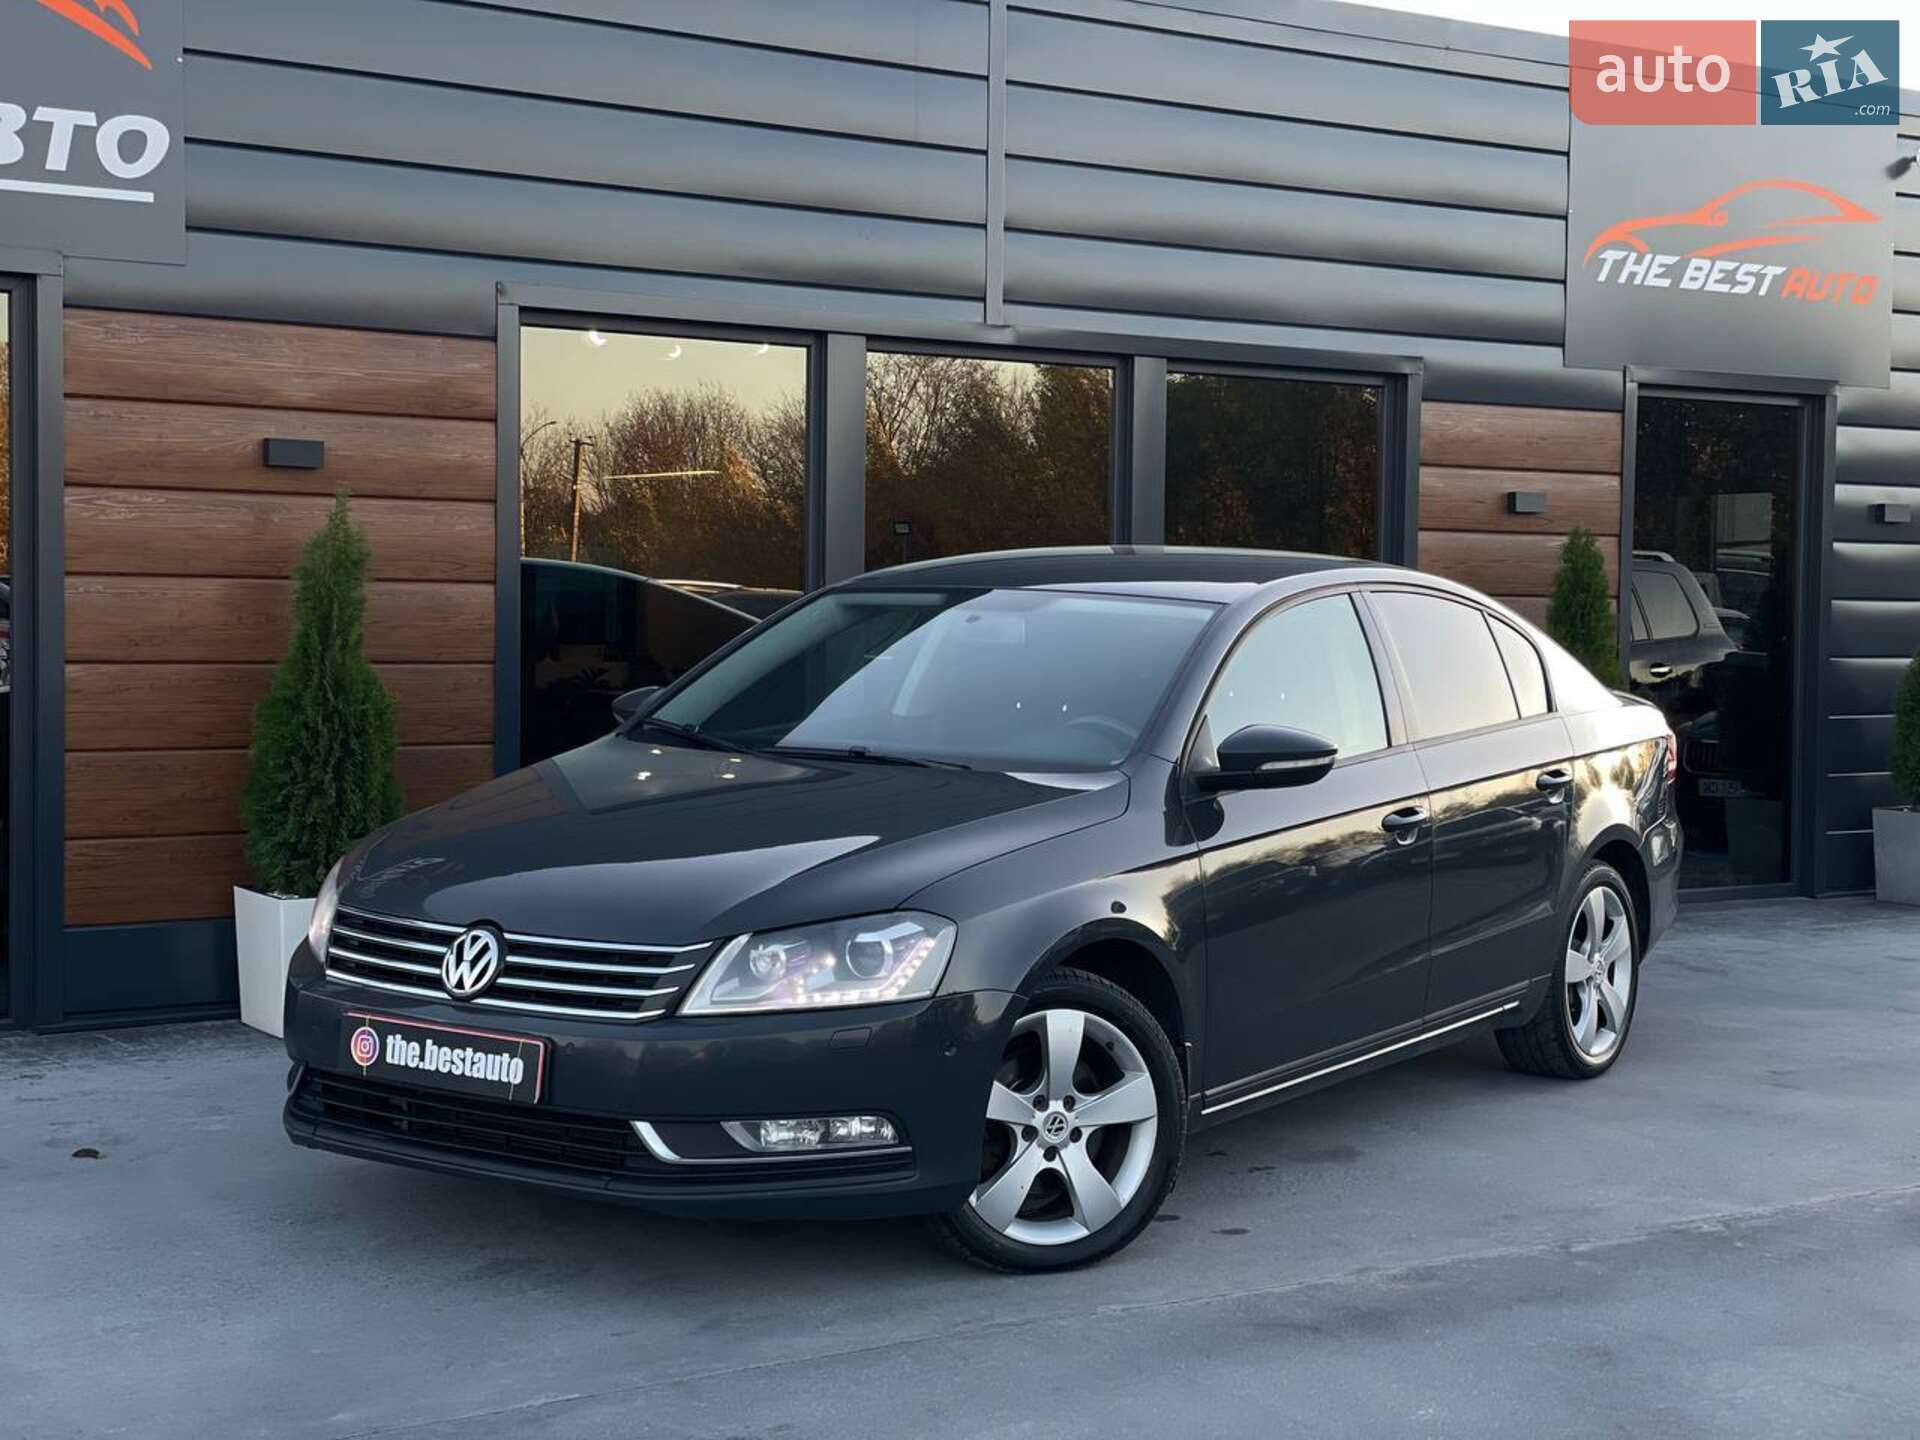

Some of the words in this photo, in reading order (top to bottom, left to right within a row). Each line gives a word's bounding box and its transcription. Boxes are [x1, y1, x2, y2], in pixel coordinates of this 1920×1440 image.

[1597, 250, 1680, 287] THE
[1679, 258, 1787, 296] BEST
[1781, 267, 1879, 304] AUTO
[385, 1033, 525, 1085] the.bestauto
